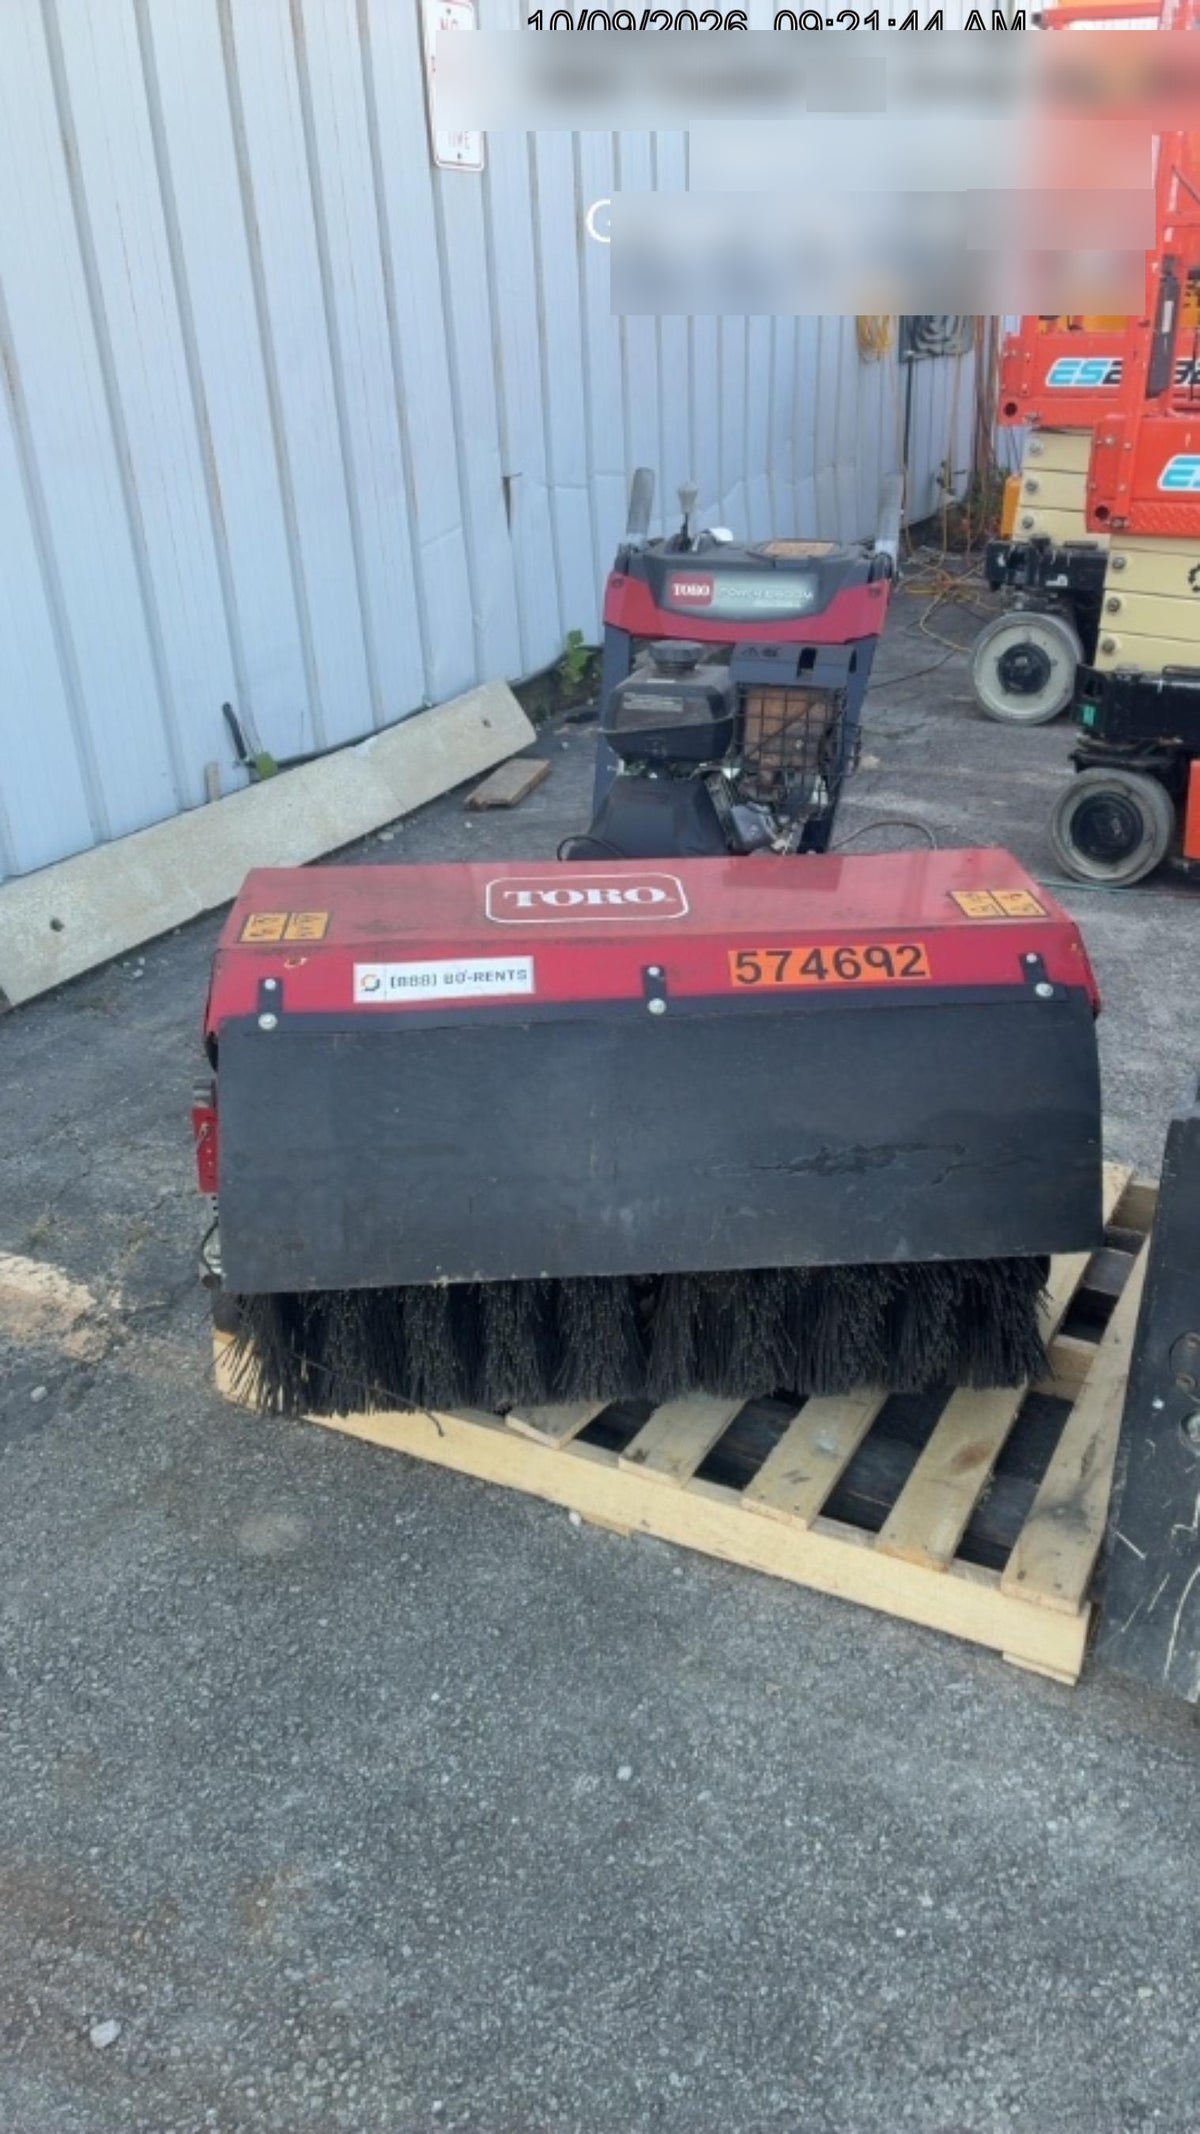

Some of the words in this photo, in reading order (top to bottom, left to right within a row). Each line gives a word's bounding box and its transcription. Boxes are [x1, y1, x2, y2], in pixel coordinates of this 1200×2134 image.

[672, 582, 711, 597] TORO
[503, 886, 667, 908] TORO
[735, 945, 926, 985] 574692
